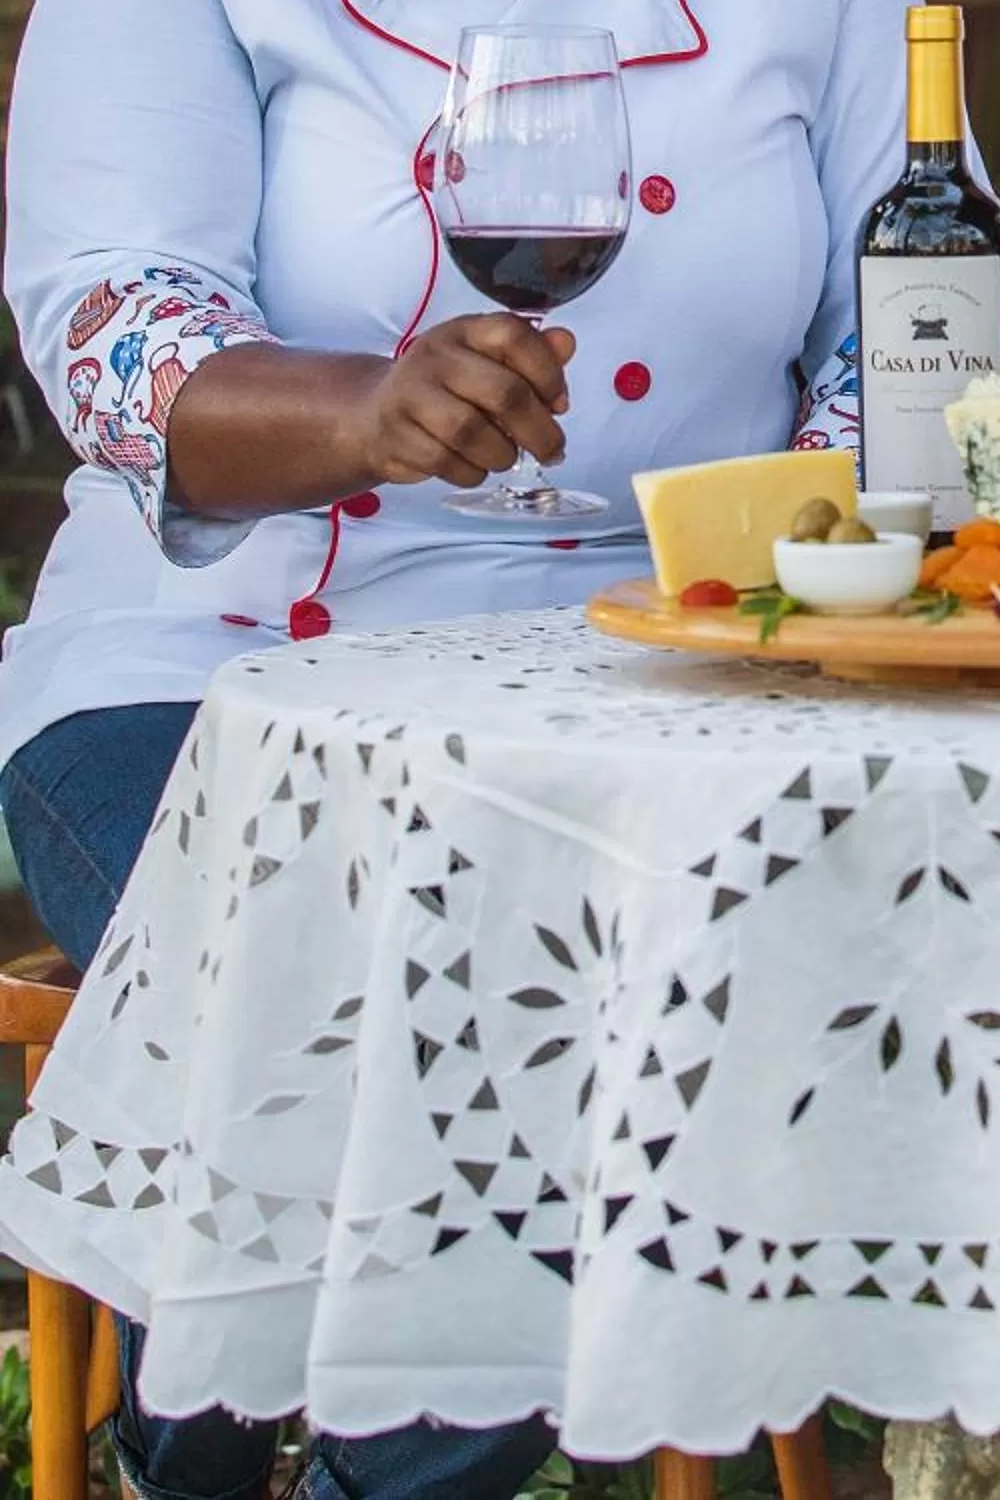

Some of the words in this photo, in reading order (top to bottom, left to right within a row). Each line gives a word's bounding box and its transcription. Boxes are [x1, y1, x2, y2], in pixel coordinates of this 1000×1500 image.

[871, 349, 915, 372] CASA
[920, 357, 942, 372] DI
[946, 349, 994, 371] VINA
